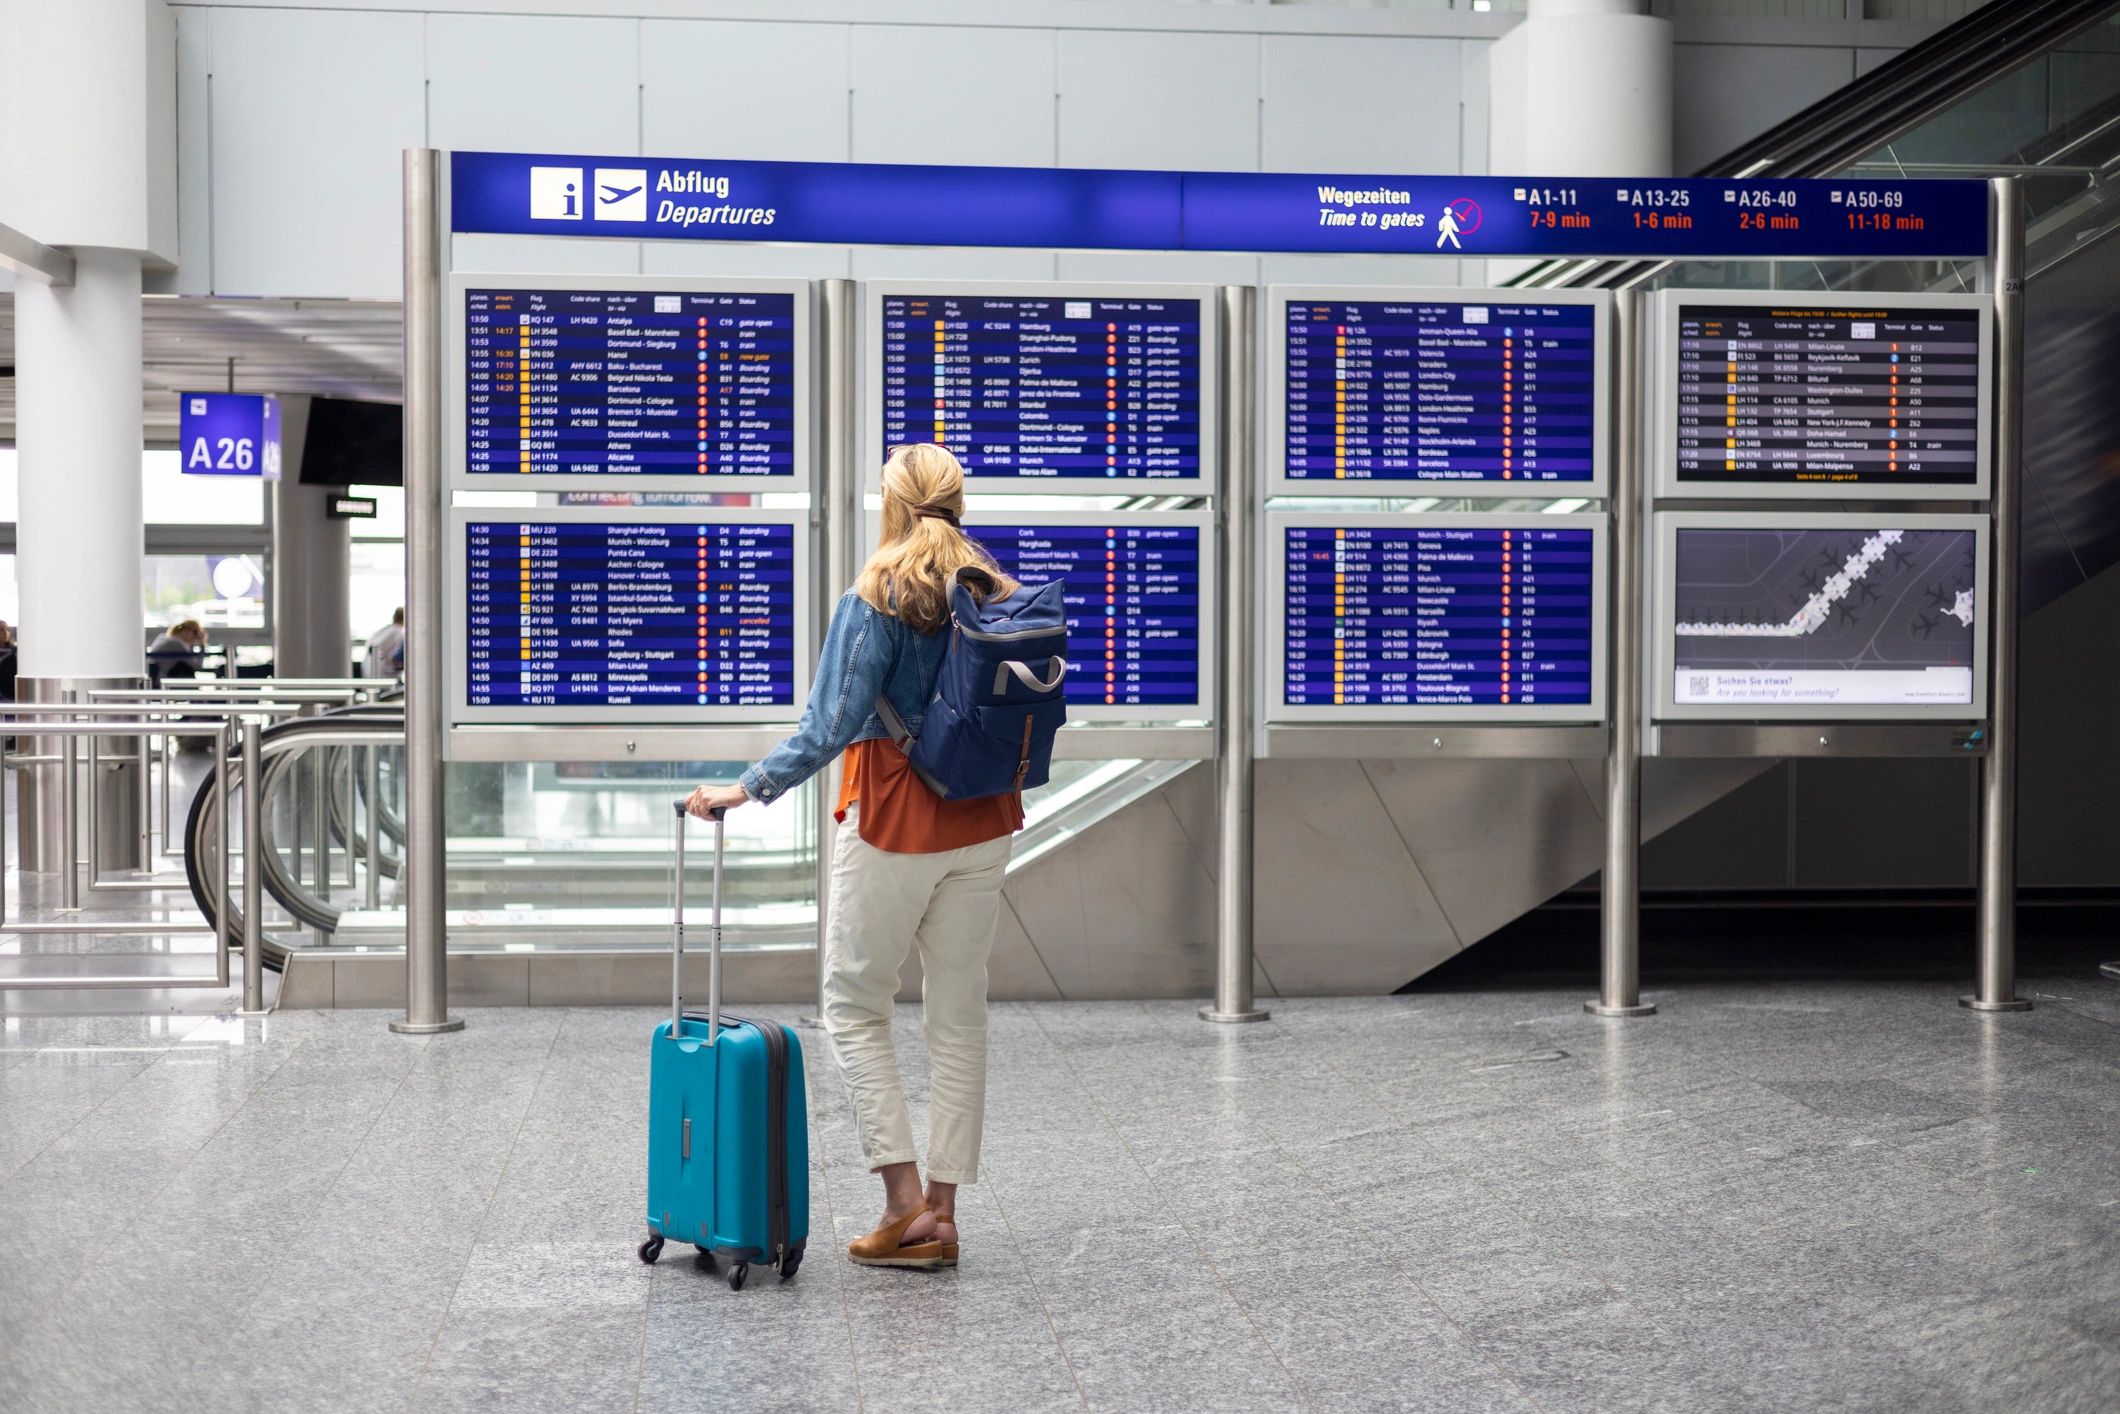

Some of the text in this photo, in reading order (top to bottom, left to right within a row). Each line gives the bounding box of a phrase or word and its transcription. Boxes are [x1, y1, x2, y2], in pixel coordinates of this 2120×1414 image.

[656, 170, 728, 198] Abflug
[1318, 187, 1410, 207] Wegezeiten
[656, 200, 777, 227] Departures
[1320, 209, 1425, 230] Time to gates
[1532, 212, 1590, 227] 7-9 min
[1634, 212, 1691, 228] 1-6 min
[1740, 213, 1798, 228] 2-6 min
[1848, 213, 1923, 229] 11-18 min
[608, 317, 632, 326] Antalya
[608, 339, 641, 347] Dortmund
[647, 339, 676, 349] Siegburg
[630, 362, 662, 371] Bucharest
[739, 364, 770, 373] Boarding
[739, 375, 770, 384] Boarding
[608, 385, 640, 393] Barcelona
[739, 386, 770, 396] Boarding
[608, 396, 673, 406] Dortmund Cologne
[608, 419, 770, 430] Montreal Boarding
[739, 527, 770, 536] Boarding
[608, 537, 756, 546] Munich train
[608, 549, 772, 559] Punta Cana gate open
[608, 560, 632, 568] Aachen
[637, 560, 664, 570] Cologne
[739, 583, 770, 592] Boarding
[608, 616, 621, 624] Fort
[623, 617, 642, 626] Myers
[608, 628, 632, 636] Rhodes
[739, 628, 770, 637] Boarding
[608, 651, 640, 660] Augsburg
[645, 650, 674, 660] Stuttgart
[1717, 676, 1793, 686] Suchen Sie etwas?
[1733, 688, 1748, 698] you
[1749, 687, 1778, 698] looking
[1780, 687, 1792, 697] for
[1794, 687, 1840, 698] something?
